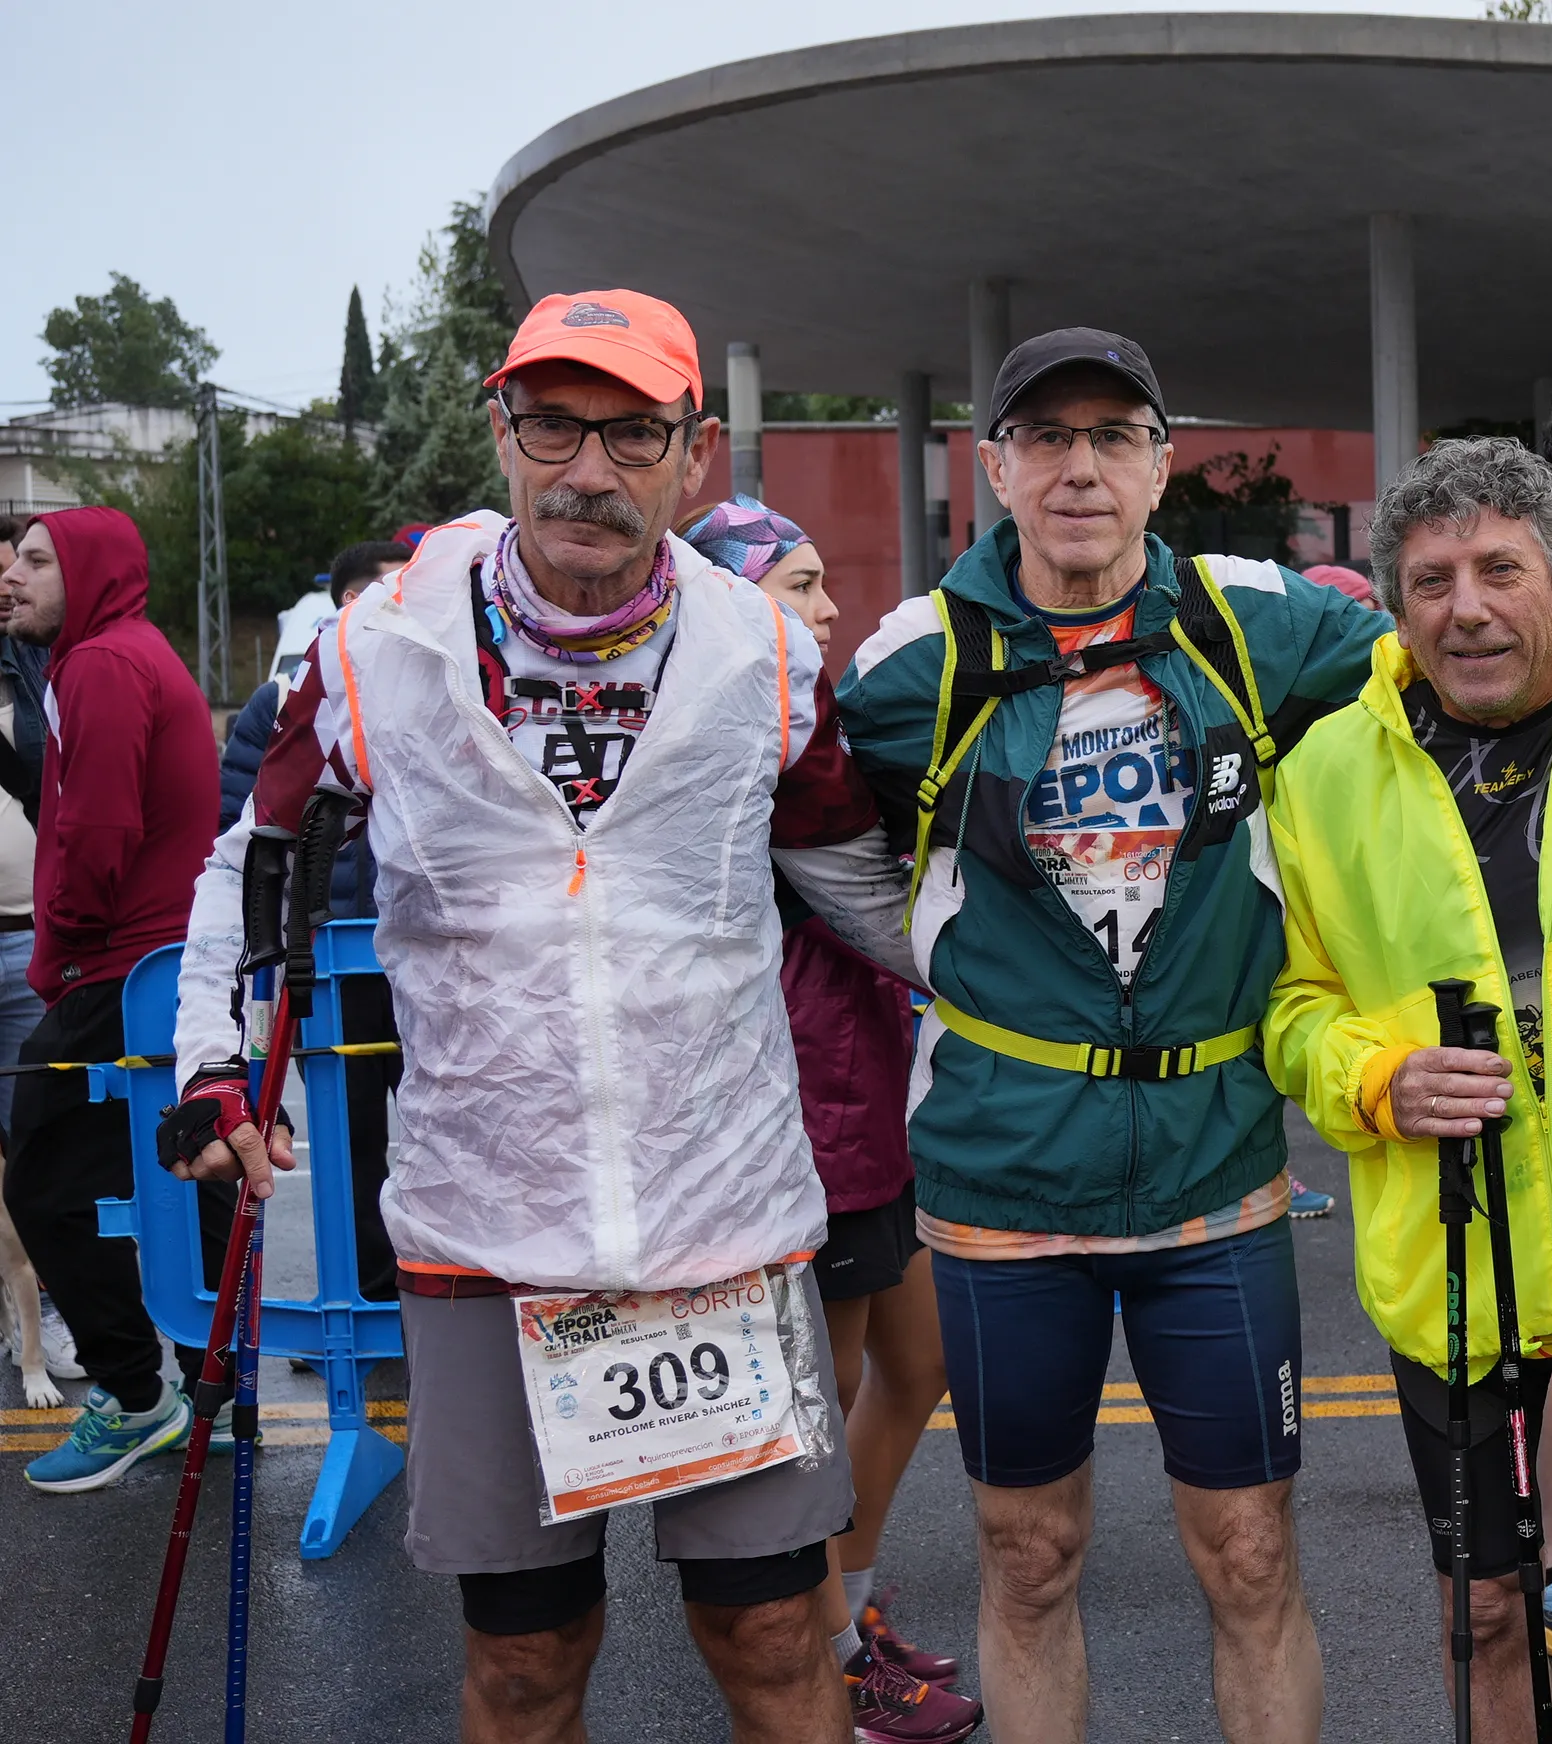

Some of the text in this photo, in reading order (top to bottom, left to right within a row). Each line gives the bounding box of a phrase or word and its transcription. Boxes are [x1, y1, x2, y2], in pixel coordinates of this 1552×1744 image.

[1070, 888, 1117, 897] RESULTADOS
[671, 1283, 766, 1319] CORTO
[553, 1307, 618, 1337] EPORA
[558, 1322, 612, 1350] TRAIL
[620, 1329, 668, 1346] RESULTADOS
[603, 1342, 731, 1421] 309
[588, 1397, 752, 1444] BARTOLOMÉ RIVERA SÁNCHEZ
[739, 1421, 781, 1441] EPORABAD
